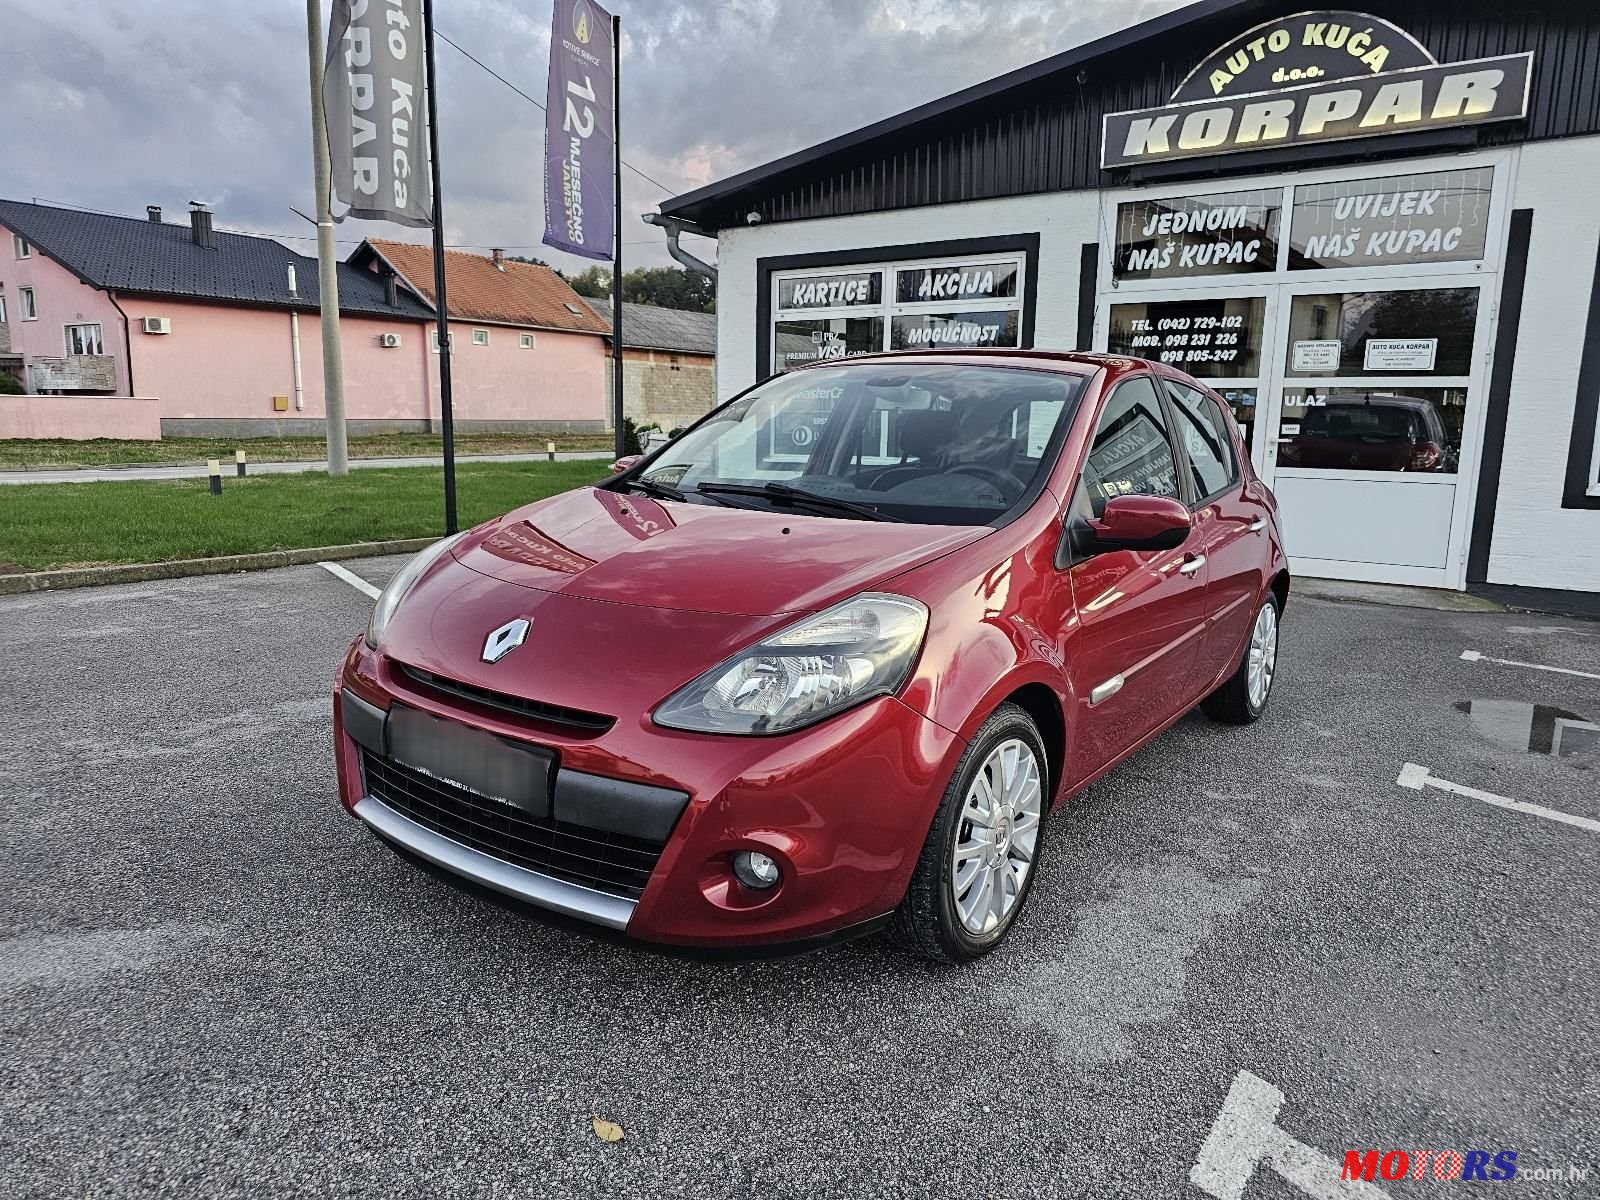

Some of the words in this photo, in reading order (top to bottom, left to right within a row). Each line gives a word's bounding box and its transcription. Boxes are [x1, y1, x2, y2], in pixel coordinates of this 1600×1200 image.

[386, 0, 410, 60] to
[1208, 27, 1290, 95] AUTO
[1302, 22, 1390, 74] KUĆA
[1271, 65, 1325, 84] d.o.o.
[563, 75, 596, 139] 12
[1122, 69, 1505, 157] KORPAR
[391, 77, 413, 209] Kuća
[561, 159, 577, 243] JAMSTVO
[566, 136, 585, 246] MJESEČNO
[1334, 190, 1441, 221] UVIJEK
[1143, 205, 1248, 237] JEDNOM
[1127, 242, 1174, 272] NAŠ
[1179, 240, 1261, 268] KUPAC
[1304, 230, 1360, 259] NAŠ
[1368, 226, 1462, 255] KUPAC
[792, 279, 870, 305] KARTICE
[918, 270, 994, 297] AKCIJA
[823, 332, 840, 341] PBZ
[907, 322, 1000, 344] MOGUĆNOST
[1131, 319, 1154, 332] TEL.
[1157, 317, 1190, 332] (042)
[1194, 315, 1243, 330] 729-102
[786, 352, 817, 360] PREMIUM
[818, 345, 847, 359] VISA
[1131, 335, 1161, 348] MOB.
[1165, 334, 1188, 347] 098
[1190, 333, 1211, 346] 231
[1215, 332, 1238, 345] 226
[1160, 350, 1184, 363] 098
[1186, 349, 1238, 362] 805-247
[1284, 394, 1327, 407] ULAZ
